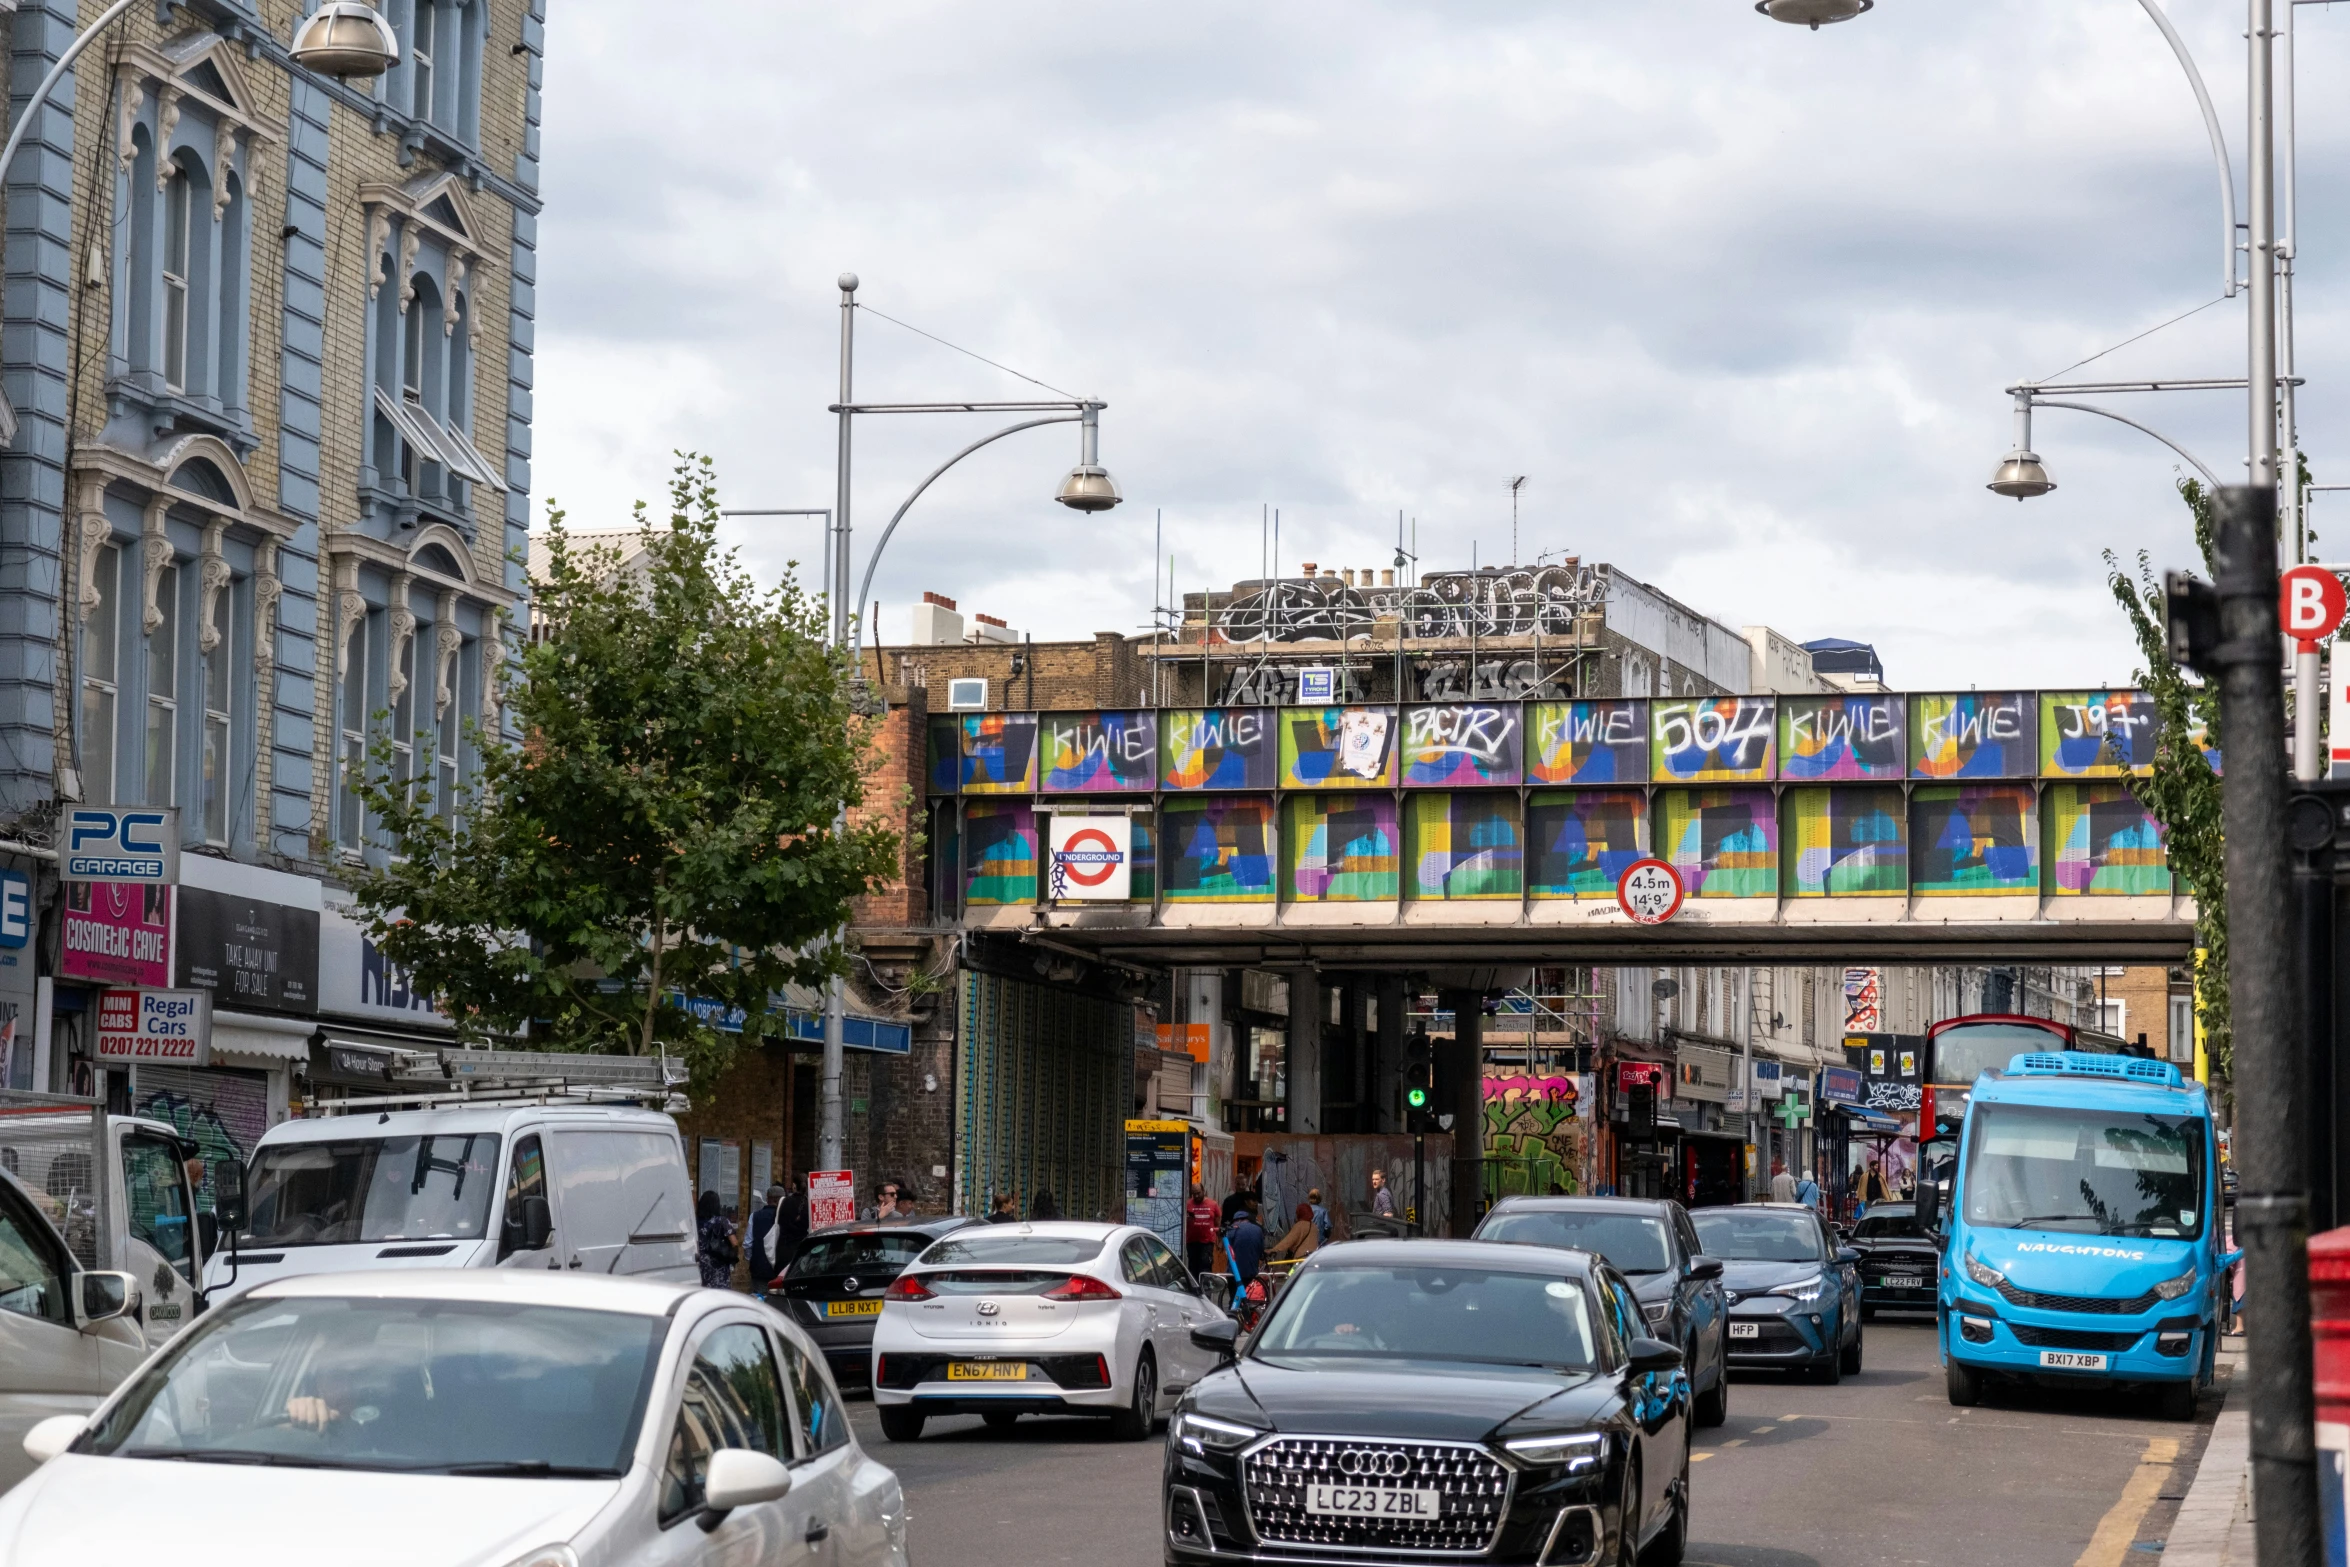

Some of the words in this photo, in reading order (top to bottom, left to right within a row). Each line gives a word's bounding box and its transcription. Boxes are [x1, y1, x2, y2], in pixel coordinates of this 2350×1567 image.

[2290, 578, 2327, 630] B
[1305, 674, 1328, 685] TS
[1169, 715, 1262, 749] KIWIE
[1541, 709, 1645, 744] KIWIE
[1789, 705, 1898, 748] KIWIE
[1923, 706, 2021, 744] KIWIE
[1053, 720, 1155, 762] KIWIE
[70, 810, 166, 855] PC
[72, 859, 160, 875] GARAGE
[132, 928, 164, 964] CAVE
[225, 943, 242, 967] TAKE
[244, 947, 263, 971] AWAY
[264, 950, 278, 973] UNIT
[234, 970, 250, 994] FOR
[251, 972, 268, 997] SALE
[103, 996, 132, 1011] MINI
[144, 996, 194, 1019] Regal
[101, 1013, 133, 1029] CABS
[727, 1008, 748, 1023] GRO
[147, 1017, 187, 1036] Cars
[100, 1036, 134, 1056] 0207
[135, 1037, 159, 1057] 221
[161, 1039, 196, 1058] 2222
[351, 1056, 367, 1070] Hour
[368, 1057, 385, 1071] Store
[835, 1210, 852, 1219] PARTY
[2017, 1243, 2145, 1260] NAUGHTONS
[1886, 1278, 1905, 1286] LC22
[1906, 1278, 1921, 1286] FRV
[150, 1306, 180, 1318] OAKWOOD
[831, 1303, 855, 1315] LL18
[858, 1302, 879, 1313] NXT
[1732, 1324, 1754, 1336] HFP
[2047, 1353, 2074, 1366] BX17
[2076, 1355, 2100, 1367] XBP
[953, 1363, 990, 1376] EN67
[993, 1363, 1021, 1377] HNY
[1317, 1488, 1377, 1511] LC23
[1383, 1491, 1428, 1514] ZBL
